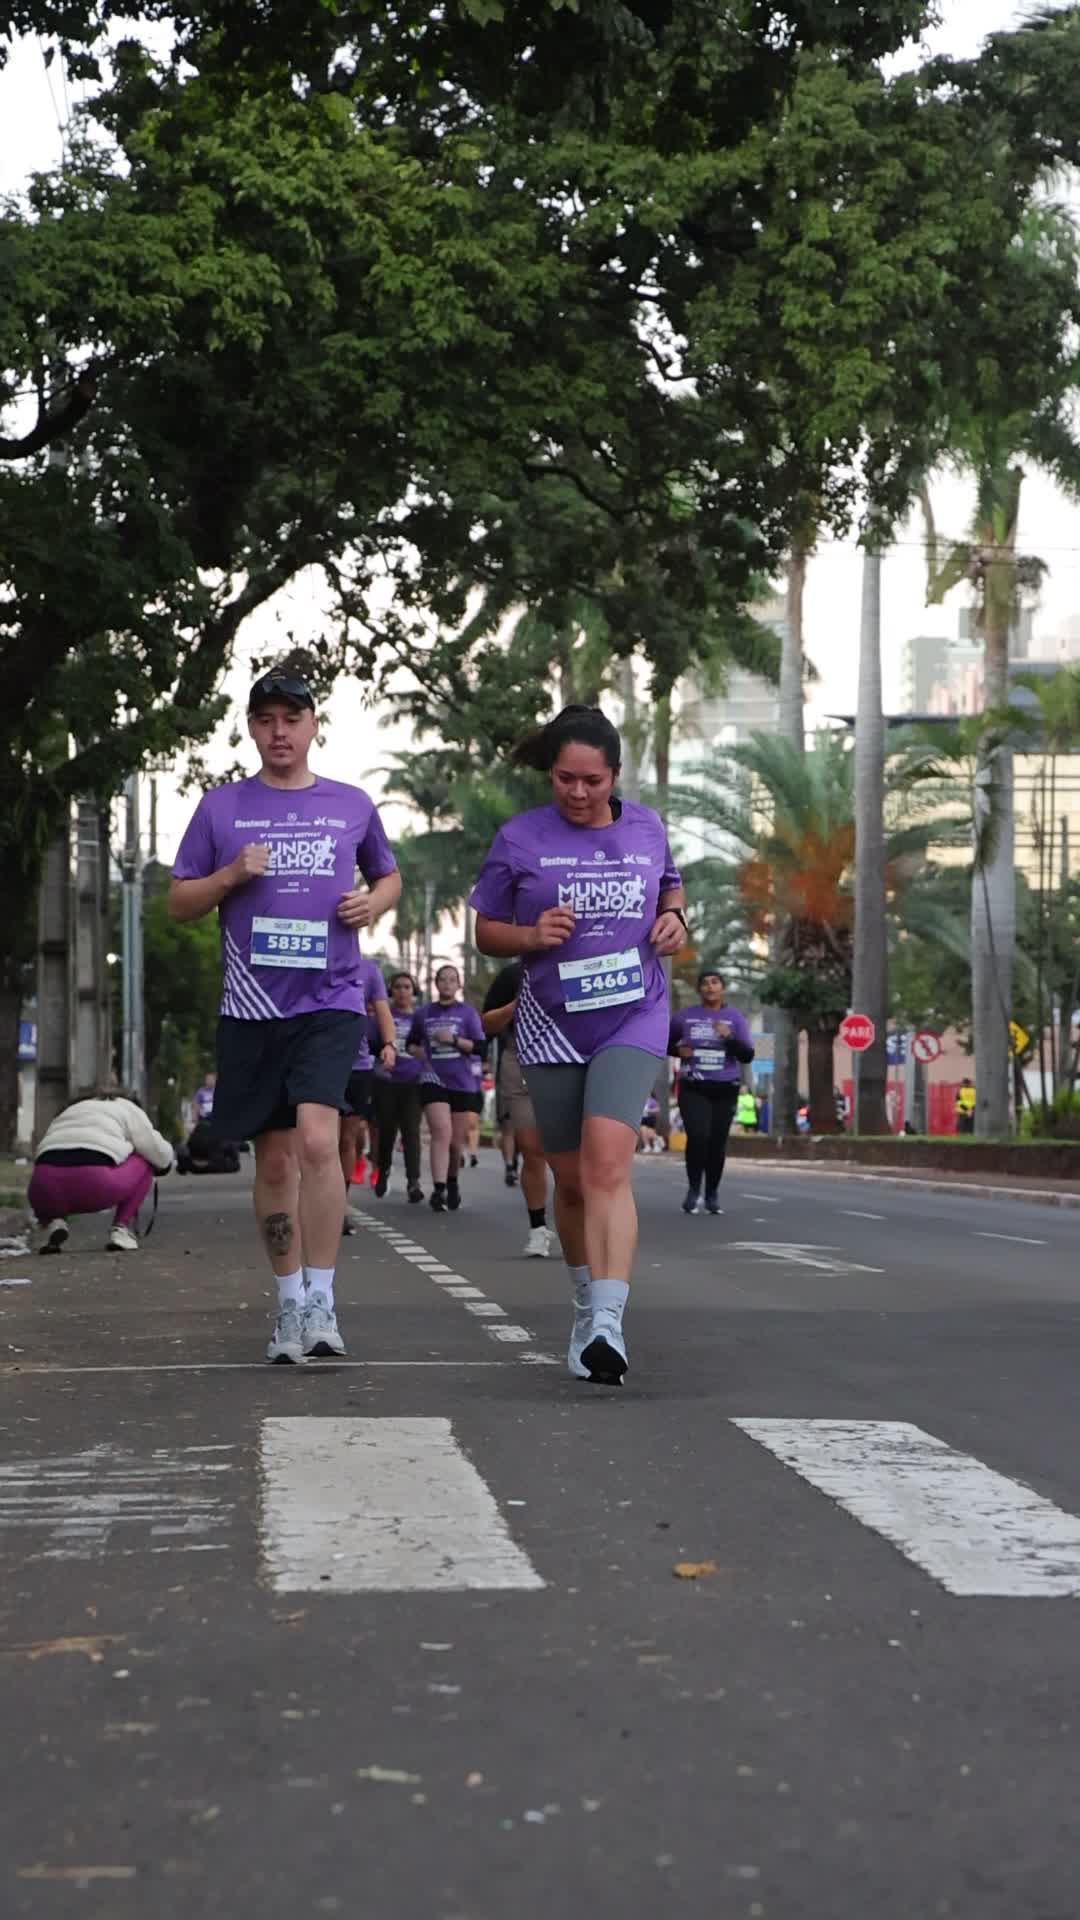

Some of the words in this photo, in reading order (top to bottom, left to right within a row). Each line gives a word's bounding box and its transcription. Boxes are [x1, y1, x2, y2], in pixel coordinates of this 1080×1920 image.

[264, 840, 324, 856] UNDO
[267, 854, 325, 868] ELHOR
[558, 881, 635, 898] MUNDO
[267, 935, 313, 952] 5835
[581, 971, 629, 993] 5466
[842, 1025, 873, 1038] PARE
